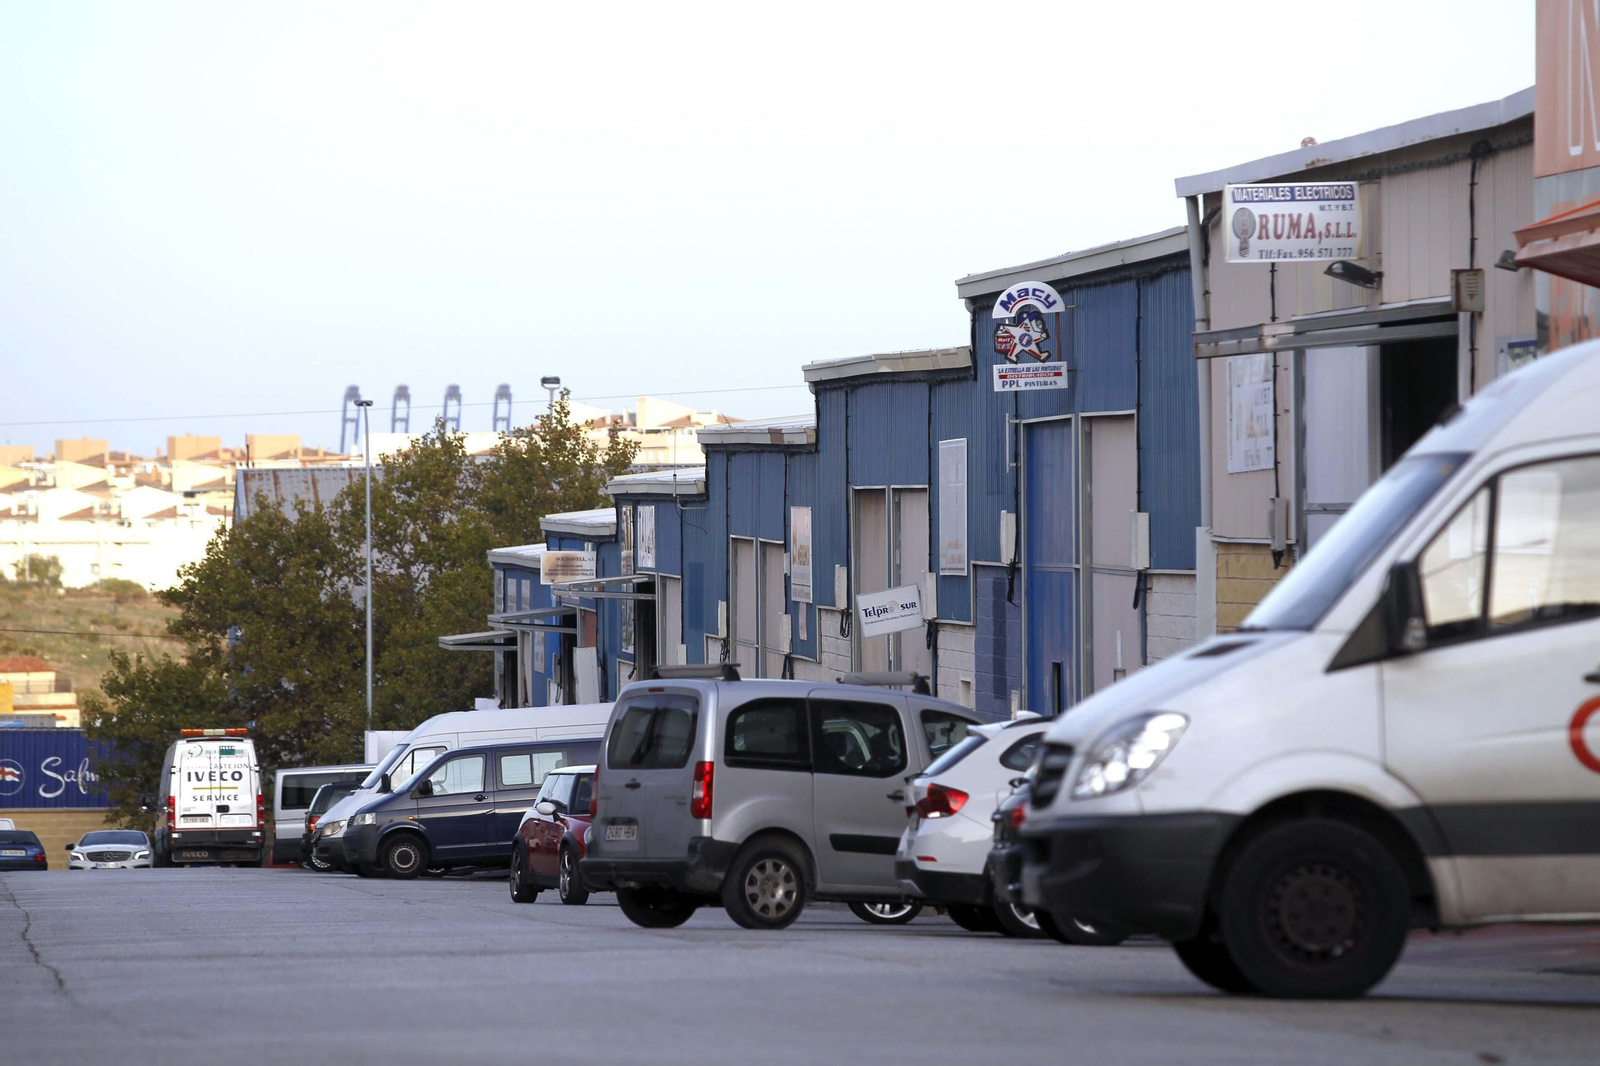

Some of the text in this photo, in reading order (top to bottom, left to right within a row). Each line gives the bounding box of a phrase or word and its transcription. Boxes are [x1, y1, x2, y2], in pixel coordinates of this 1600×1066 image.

[1234, 185, 1353, 201] MATERIALES ELECTRICOS
[1337, 247, 1353, 257] 777
[1002, 380, 1058, 388] PPL PINTURAS
[187, 771, 243, 782] IVECO
[192, 794, 239, 802] SERVICE
[182, 850, 209, 858] IVECO
